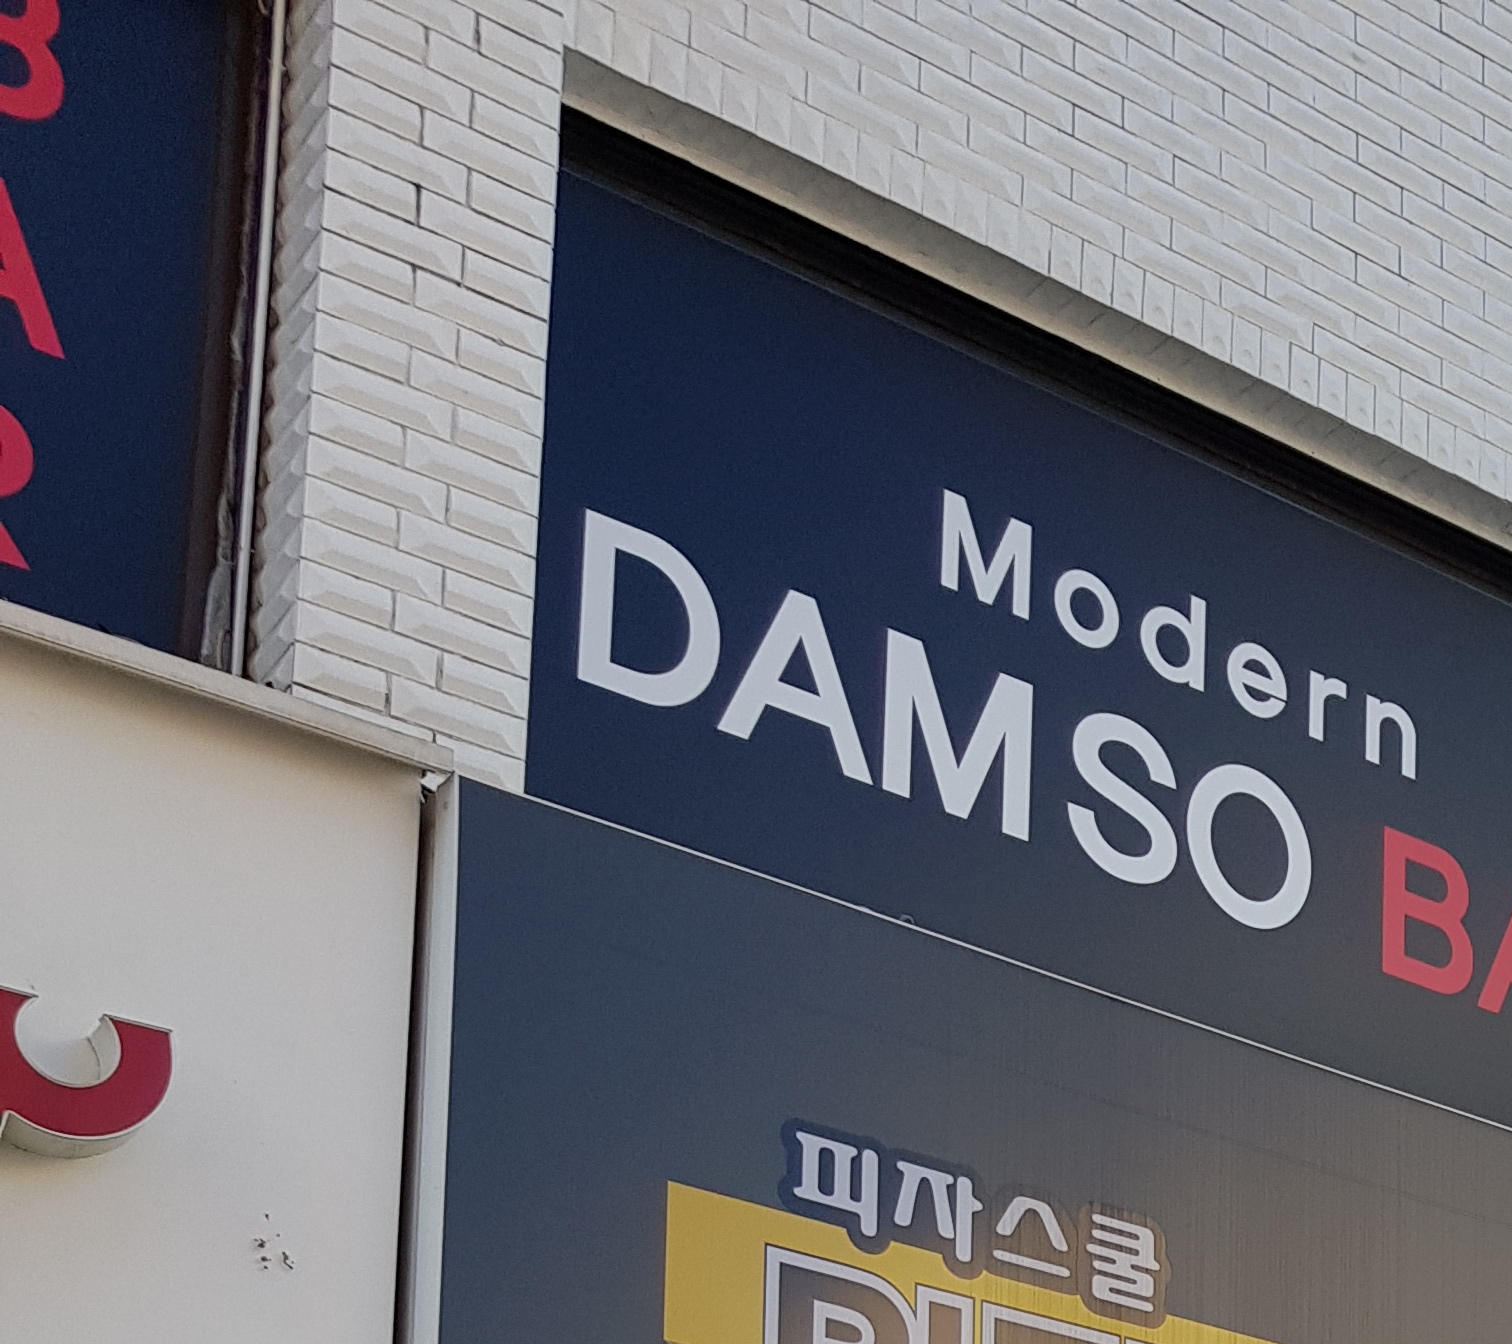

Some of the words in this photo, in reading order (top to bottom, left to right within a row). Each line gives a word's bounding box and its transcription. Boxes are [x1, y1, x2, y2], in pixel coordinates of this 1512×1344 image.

[576, 507, 1313, 931] DAMSO
[940, 487, 1418, 780] Modern
[792, 1128, 1166, 1316] 피자스쿨
